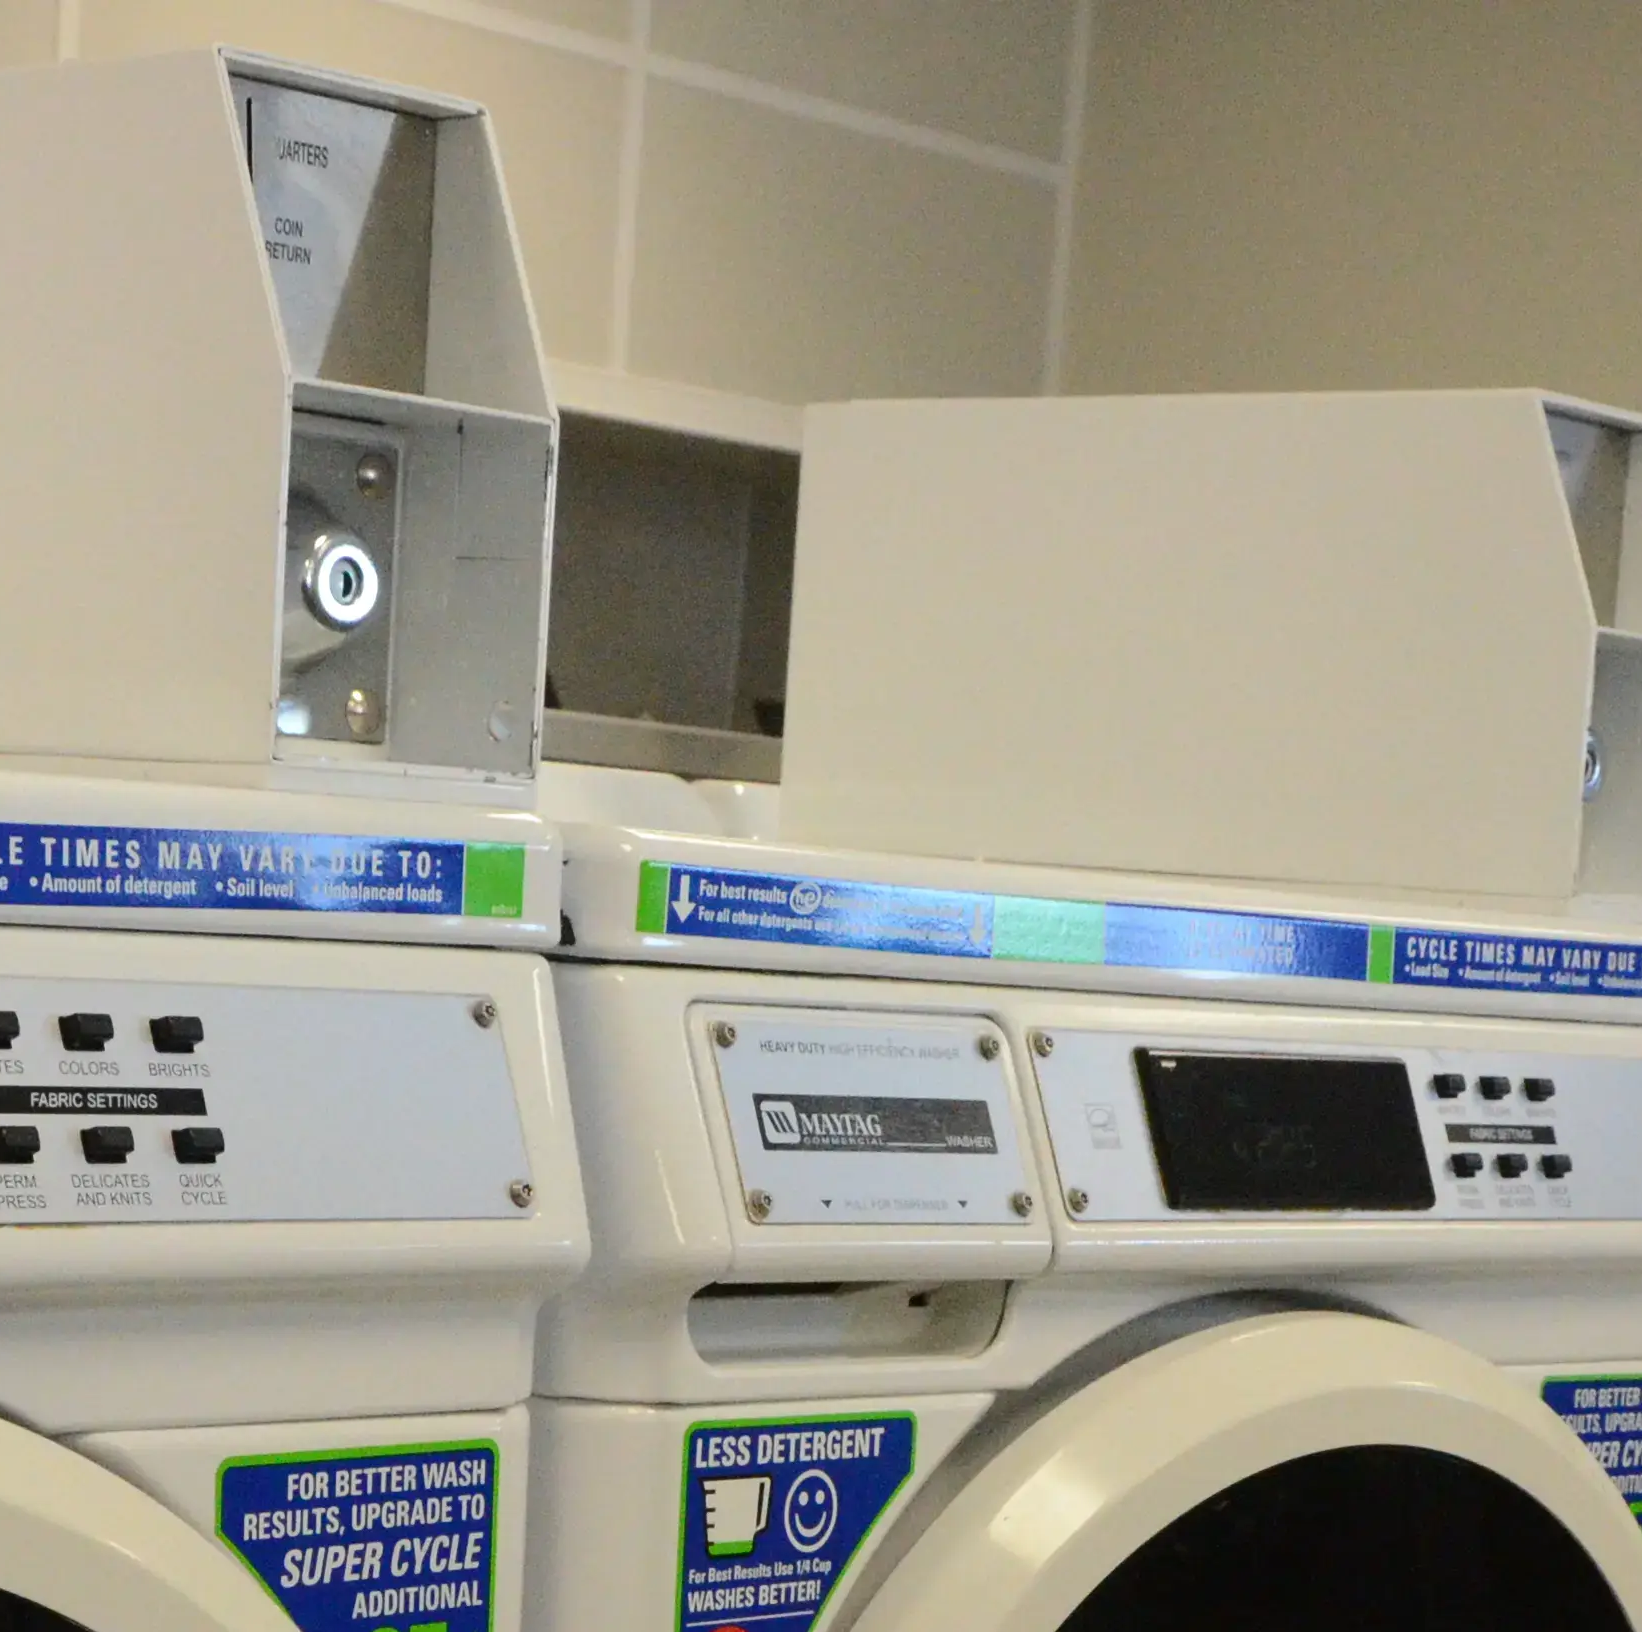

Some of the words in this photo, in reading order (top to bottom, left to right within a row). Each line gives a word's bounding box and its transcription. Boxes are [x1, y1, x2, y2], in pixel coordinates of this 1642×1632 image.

[277, 137, 330, 169] UARTERS
[274, 216, 303, 238] COIN
[265, 240, 312, 265] RETURN
[40, 837, 141, 869] TIMES
[157, 841, 223, 871] MAY
[331, 849, 384, 877] DUE
[400, 850, 442, 879] TO:
[41, 873, 102, 893] Amount
[106, 874, 122, 894] of
[124, 875, 197, 899] detergent
[226, 878, 256, 897] Soil
[259, 879, 295, 898] level
[407, 882, 443, 903] loads
[698, 878, 720, 899] For
[720, 881, 746, 900] best
[748, 885, 787, 903] results
[697, 905, 715, 923] For
[731, 910, 757, 927] other
[1407, 936, 1457, 961] CYCLE
[1465, 940, 1514, 966] TIMES
[1521, 944, 1556, 968] MAY
[1563, 947, 1601, 970] VARY
[1607, 950, 1639, 972] DUE
[759, 1039, 795, 1053] HEAVY
[797, 1041, 825, 1054] DUTY
[58, 1060, 120, 1076] COLORS
[148, 1062, 211, 1078] BRIGHTS
[30, 1092, 84, 1109] FABRIC
[87, 1092, 158, 1109] SETTINGS
[800, 1113, 882, 1137] MAYTAG
[803, 1136, 886, 1146] COMMERCIAL
[945, 1136, 994, 1148] WASHER
[70, 1174, 150, 1189] DELICATES
[179, 1173, 224, 1189] QUICK
[76, 1192, 106, 1206] AND
[109, 1192, 153, 1206] KNITS
[181, 1191, 228, 1206] CYCLE
[1573, 1388, 1596, 1408] FOR
[1598, 1386, 1641, 1408] BETTER
[695, 1435, 751, 1469] LESS
[757, 1427, 885, 1465] DETERGENT
[1587, 1441, 1621, 1469] PER
[287, 1471, 330, 1502] FOR
[335, 1464, 417, 1498] BETTER
[422, 1458, 487, 1490] WASH
[243, 1505, 345, 1542] RESULTS,
[351, 1495, 453, 1532] UPGRADE
[458, 1493, 485, 1521] TO
[280, 1540, 384, 1589] SUPER
[390, 1531, 484, 1578] CYCLE
[688, 1568, 706, 1585] For
[708, 1565, 732, 1583] Best
[734, 1562, 772, 1580] Results
[774, 1561, 793, 1576] Use
[812, 1557, 832, 1576] Cup
[352, 1580, 483, 1620] ADDITIONAL
[687, 1585, 754, 1613] WASHES
[758, 1579, 821, 1606] BETTER!
